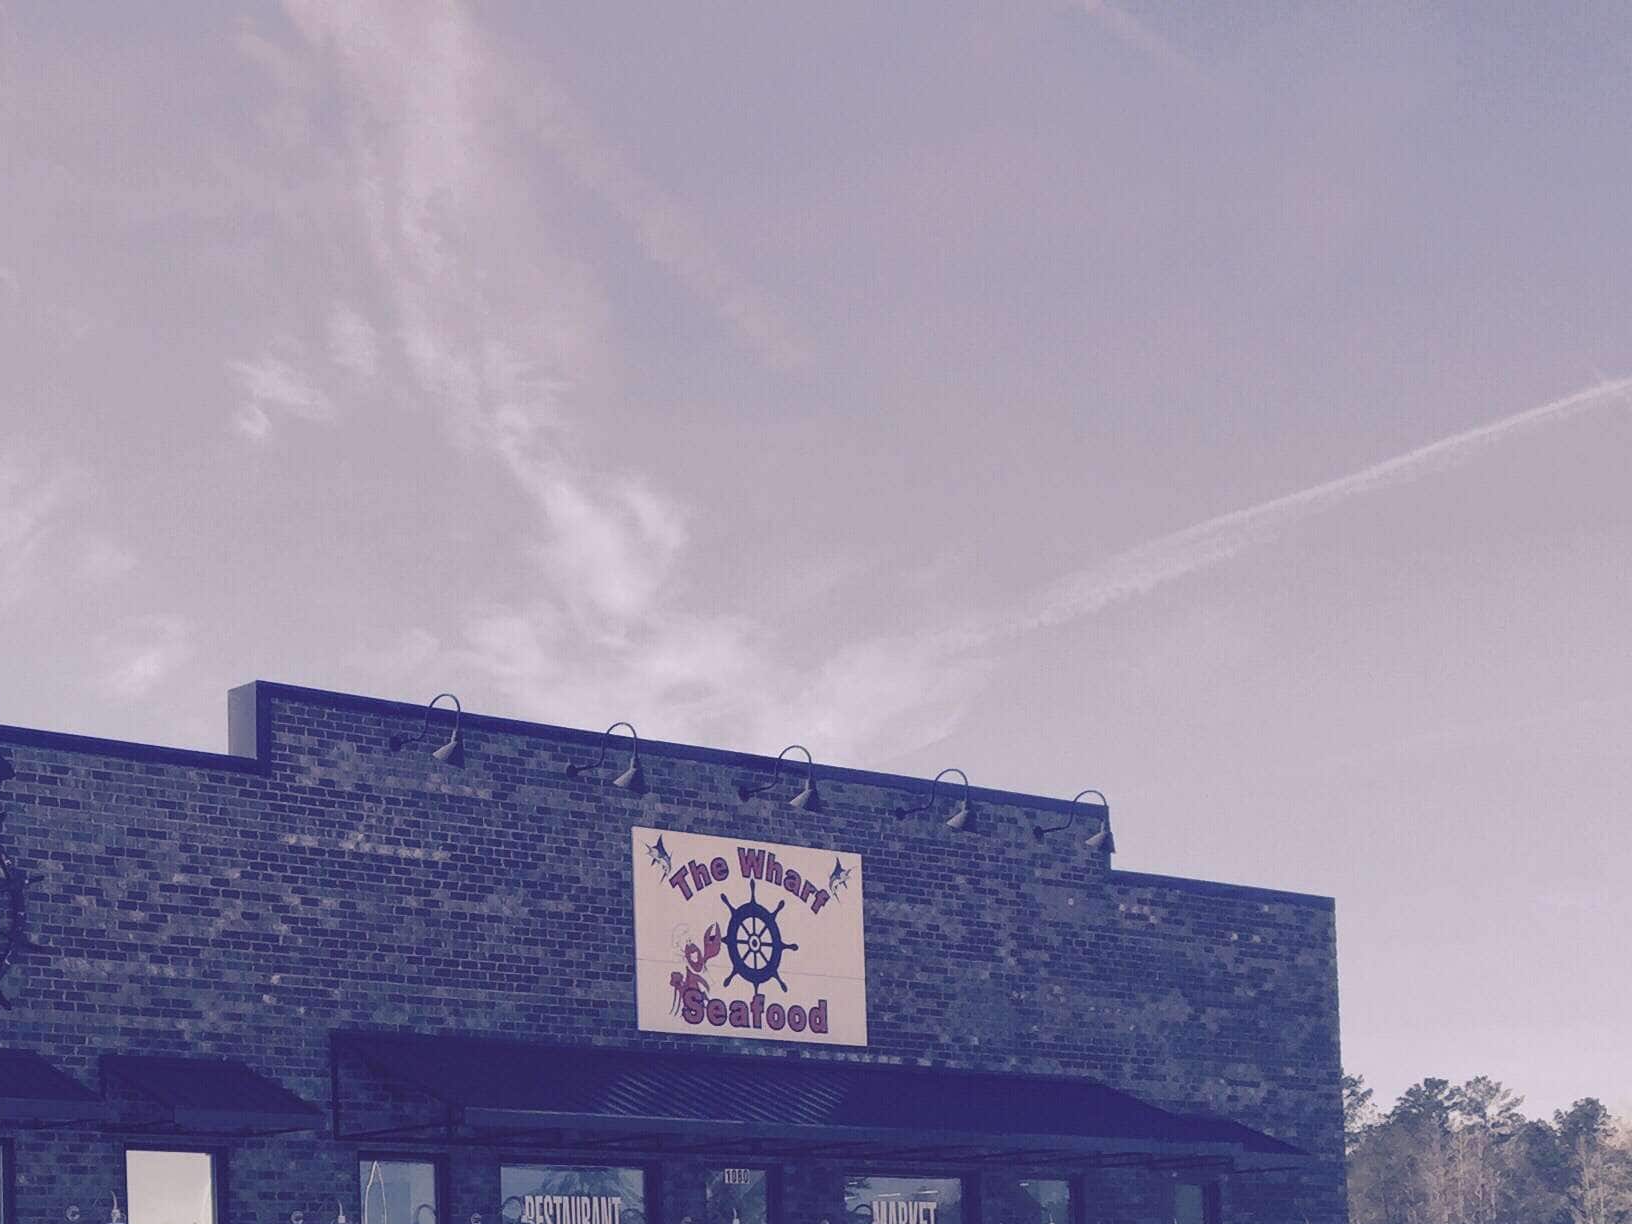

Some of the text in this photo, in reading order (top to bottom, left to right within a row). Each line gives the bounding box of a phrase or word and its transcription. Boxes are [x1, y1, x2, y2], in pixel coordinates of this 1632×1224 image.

[668, 846, 831, 915] The Wharf
[682, 987, 829, 1034] Seafood
